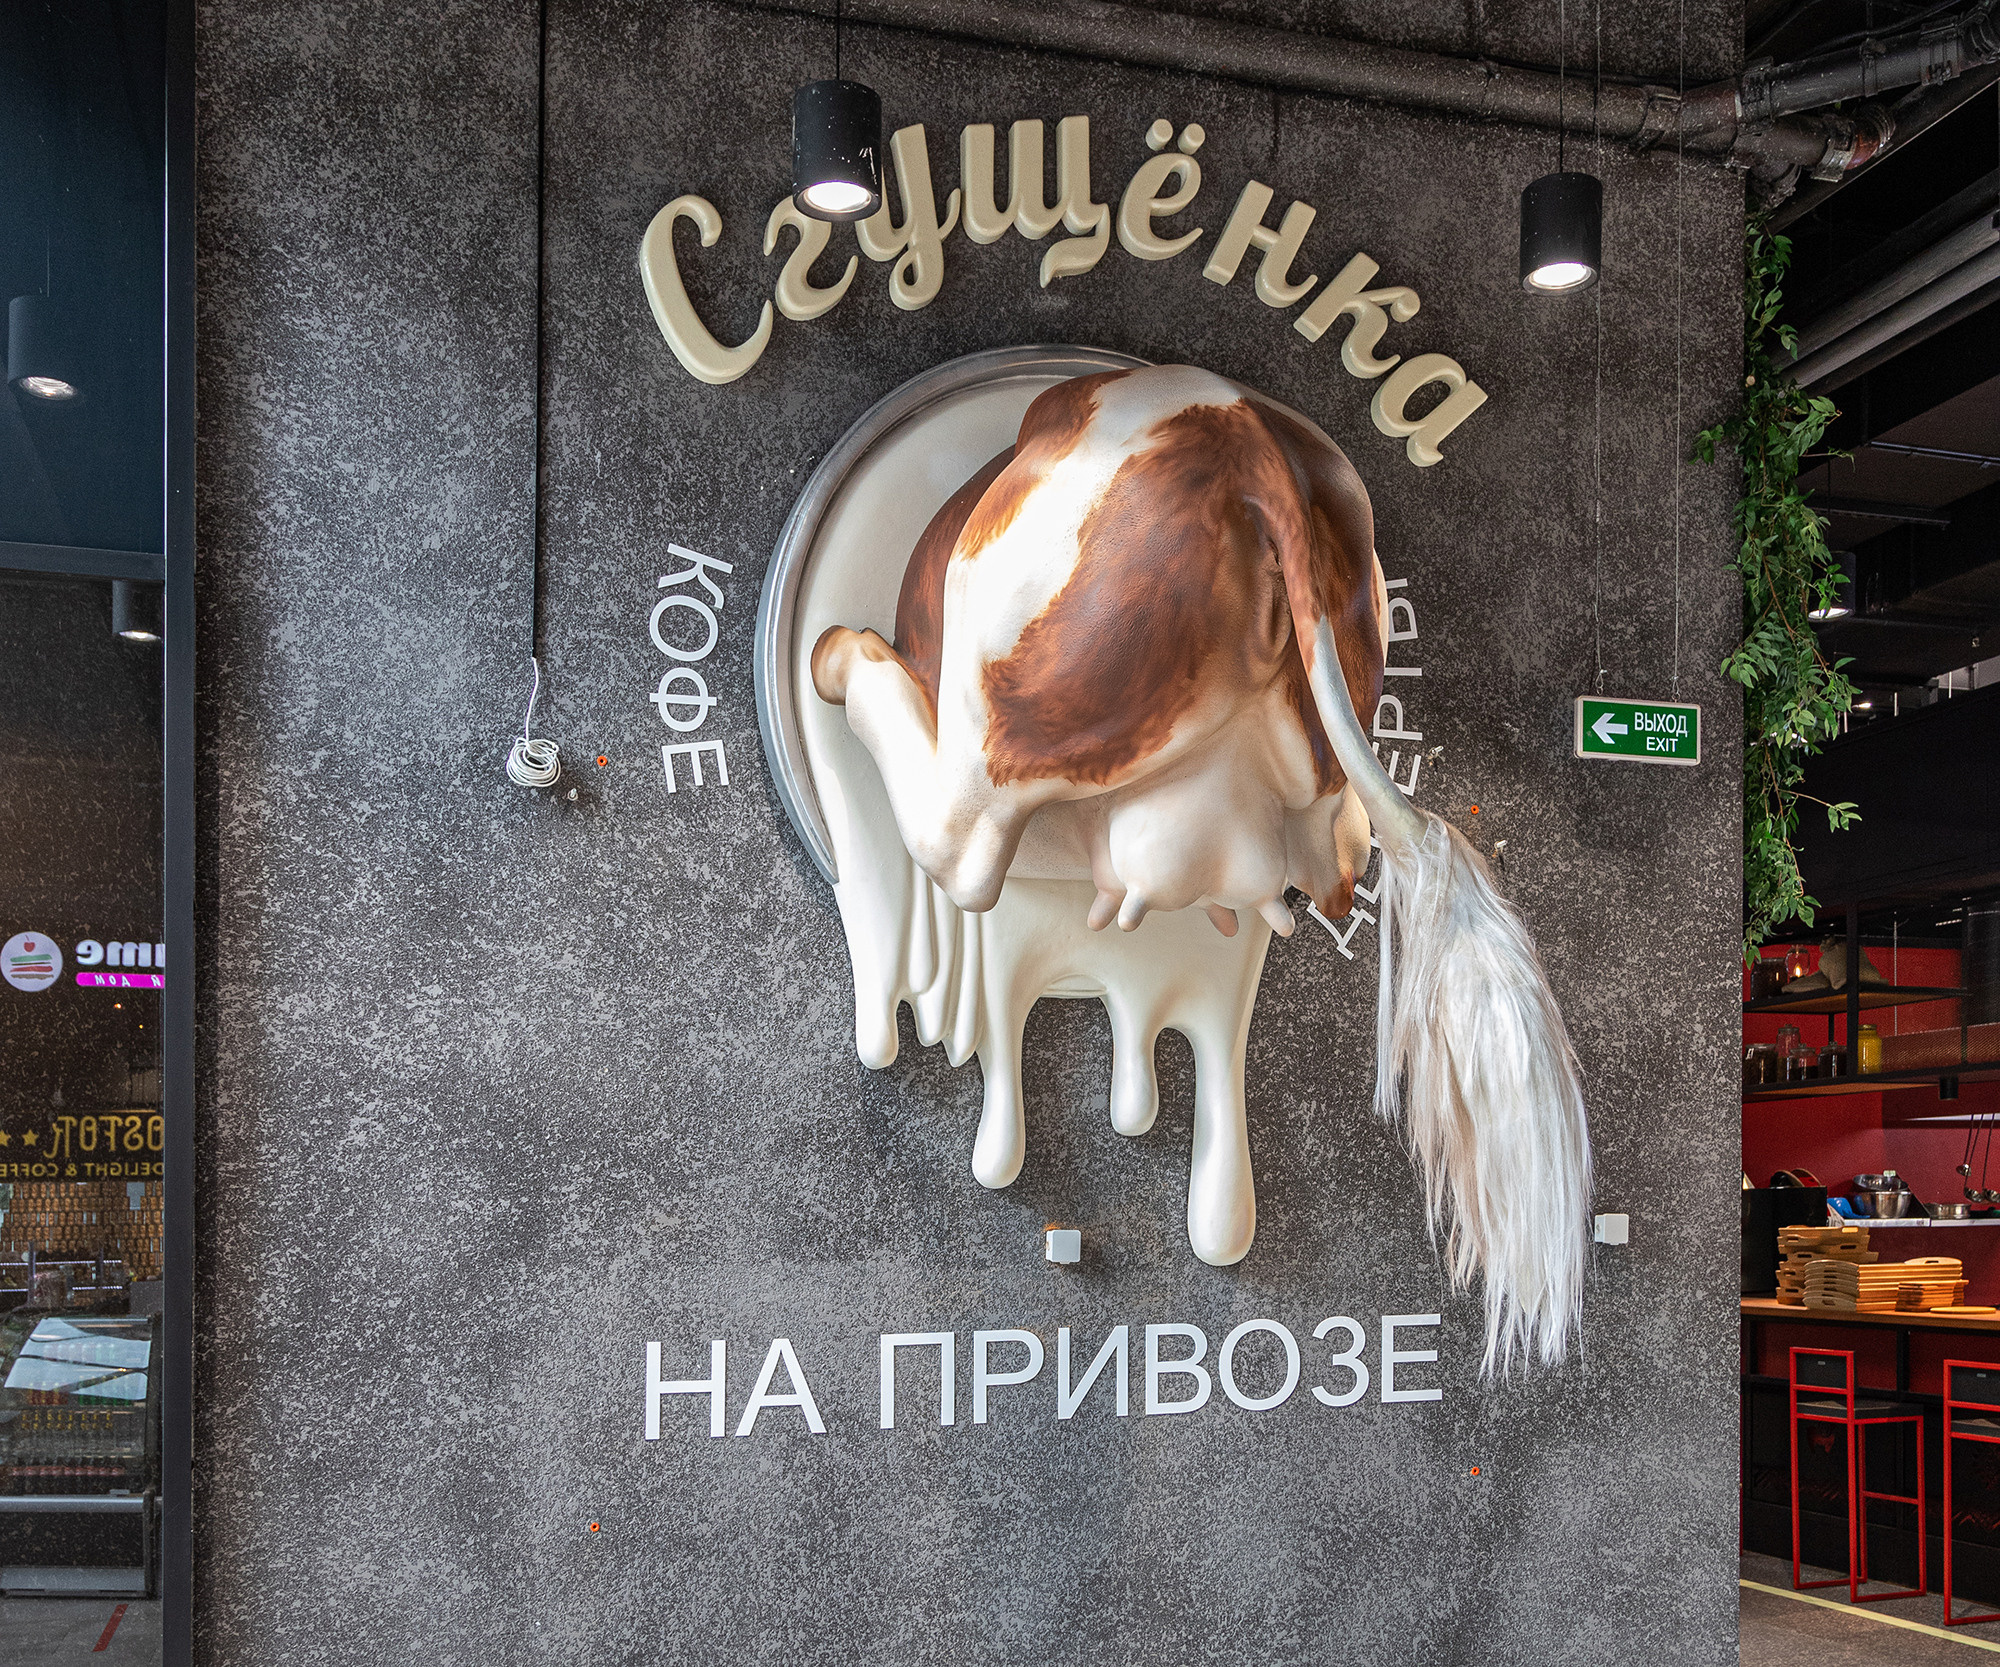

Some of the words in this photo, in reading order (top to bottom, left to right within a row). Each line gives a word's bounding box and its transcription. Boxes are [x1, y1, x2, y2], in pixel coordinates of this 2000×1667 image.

[638, 115, 1489, 467] Сгущёнка
[649, 542, 734, 794] КОФЕ
[1634, 711, 1688, 738] ВЫХОД
[1646, 736, 1679, 753] EXIT
[645, 1337, 828, 1440] НА
[879, 1312, 1443, 1429] ПРИВОЗЕ
